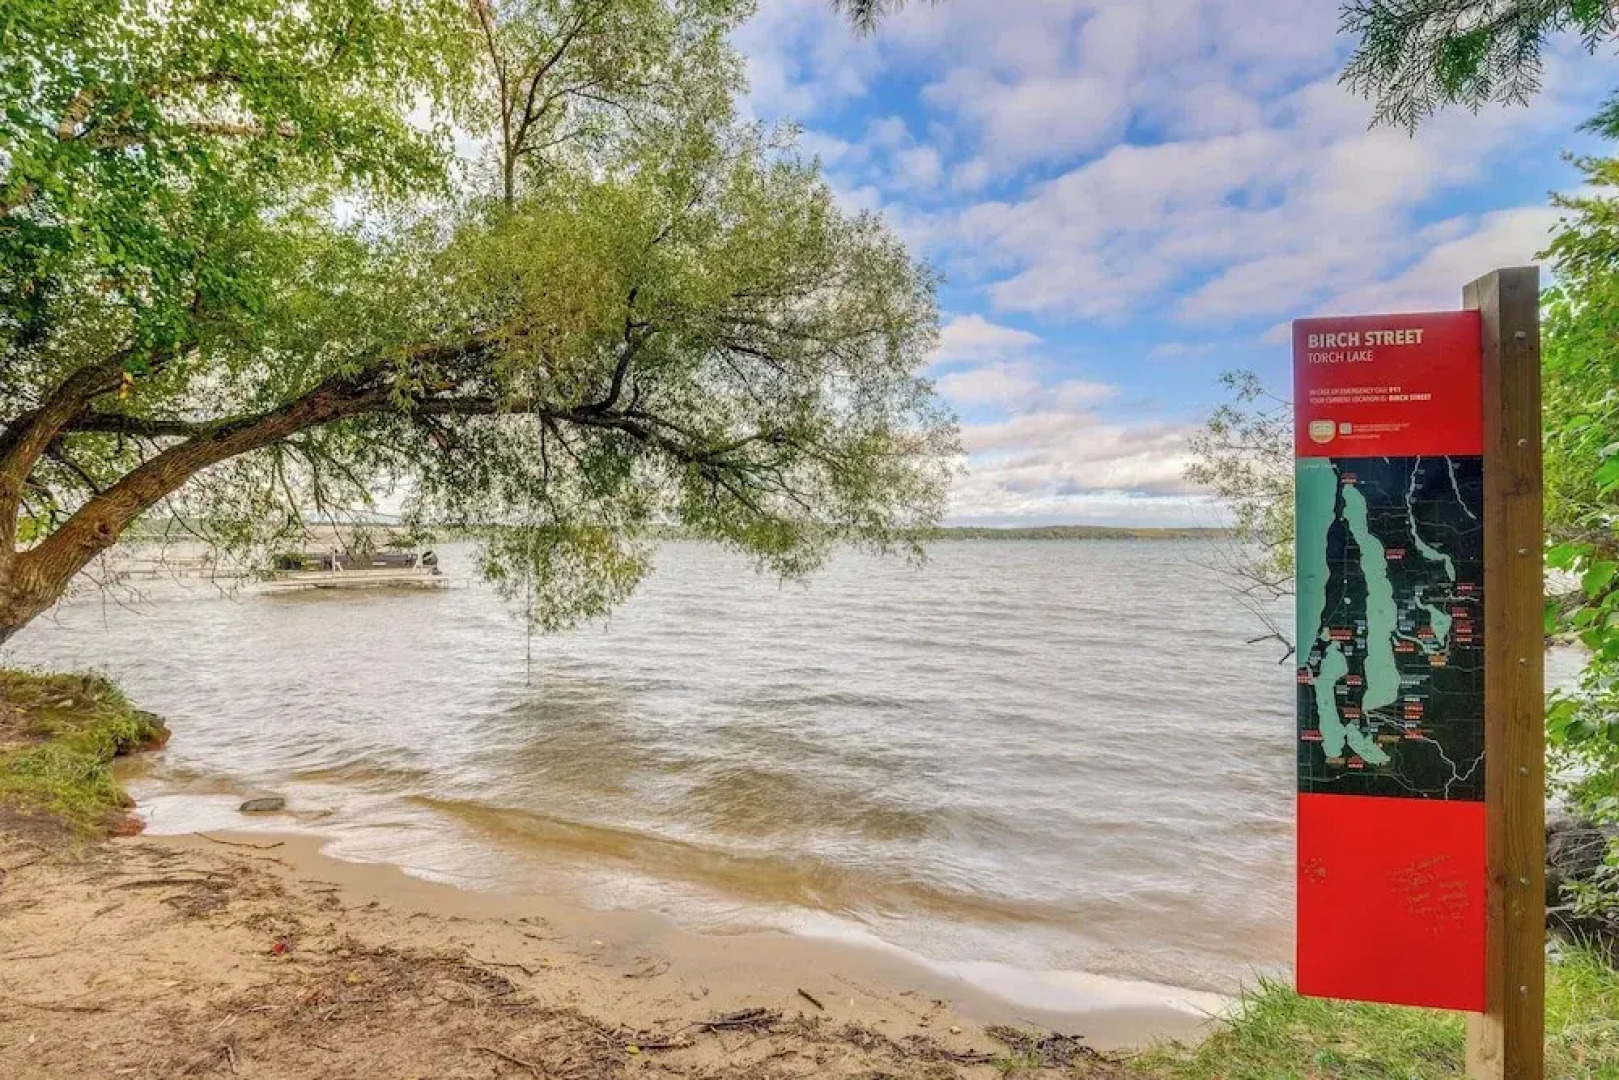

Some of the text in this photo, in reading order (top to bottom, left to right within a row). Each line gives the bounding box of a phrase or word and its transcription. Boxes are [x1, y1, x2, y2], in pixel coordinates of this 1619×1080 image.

[1308, 329, 1424, 348] BIRCH STREET
[1308, 350, 1373, 363] TORCH LAKE
[1339, 387, 1373, 395] EMERGENCY
[1388, 394, 1408, 402] BIRCH
[1409, 392, 1431, 401] STREET
